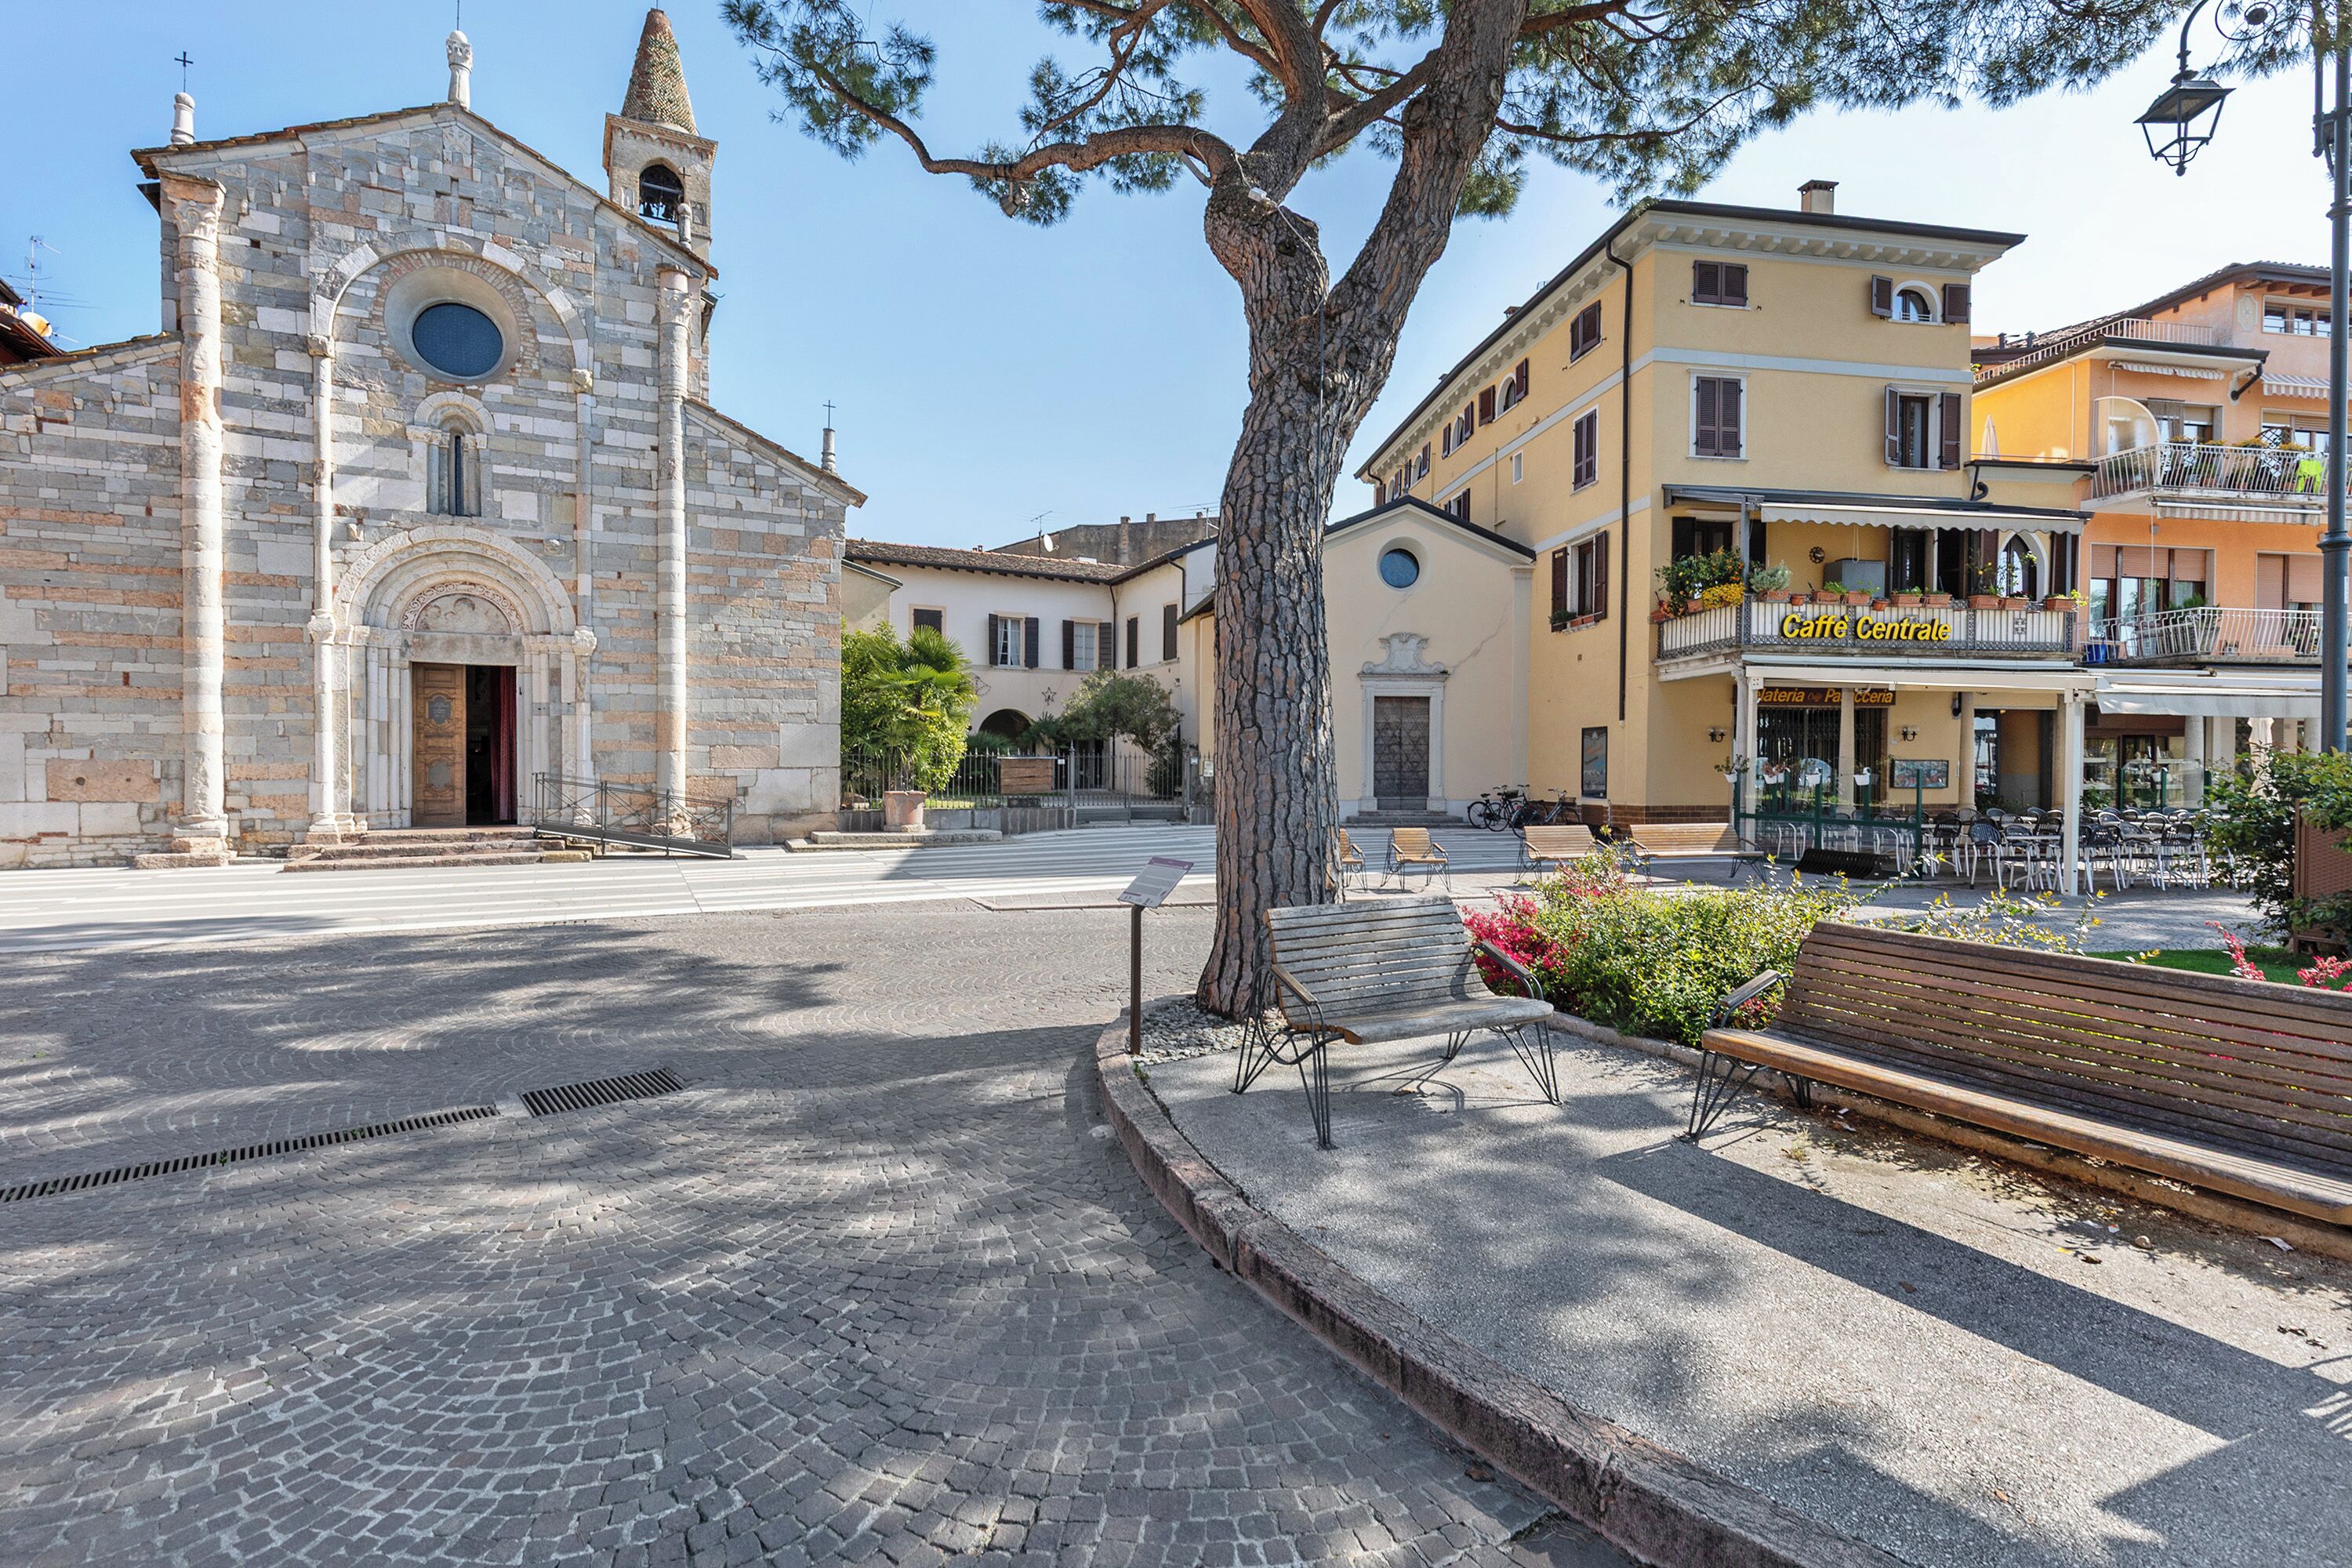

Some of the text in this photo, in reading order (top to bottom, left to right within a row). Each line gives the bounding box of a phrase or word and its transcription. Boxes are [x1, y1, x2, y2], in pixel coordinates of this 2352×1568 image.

[1783, 614, 1951, 641] Caffè Centrale
[1757, 688, 1805, 702] lateria
[1824, 688, 1893, 703] Pacceria
